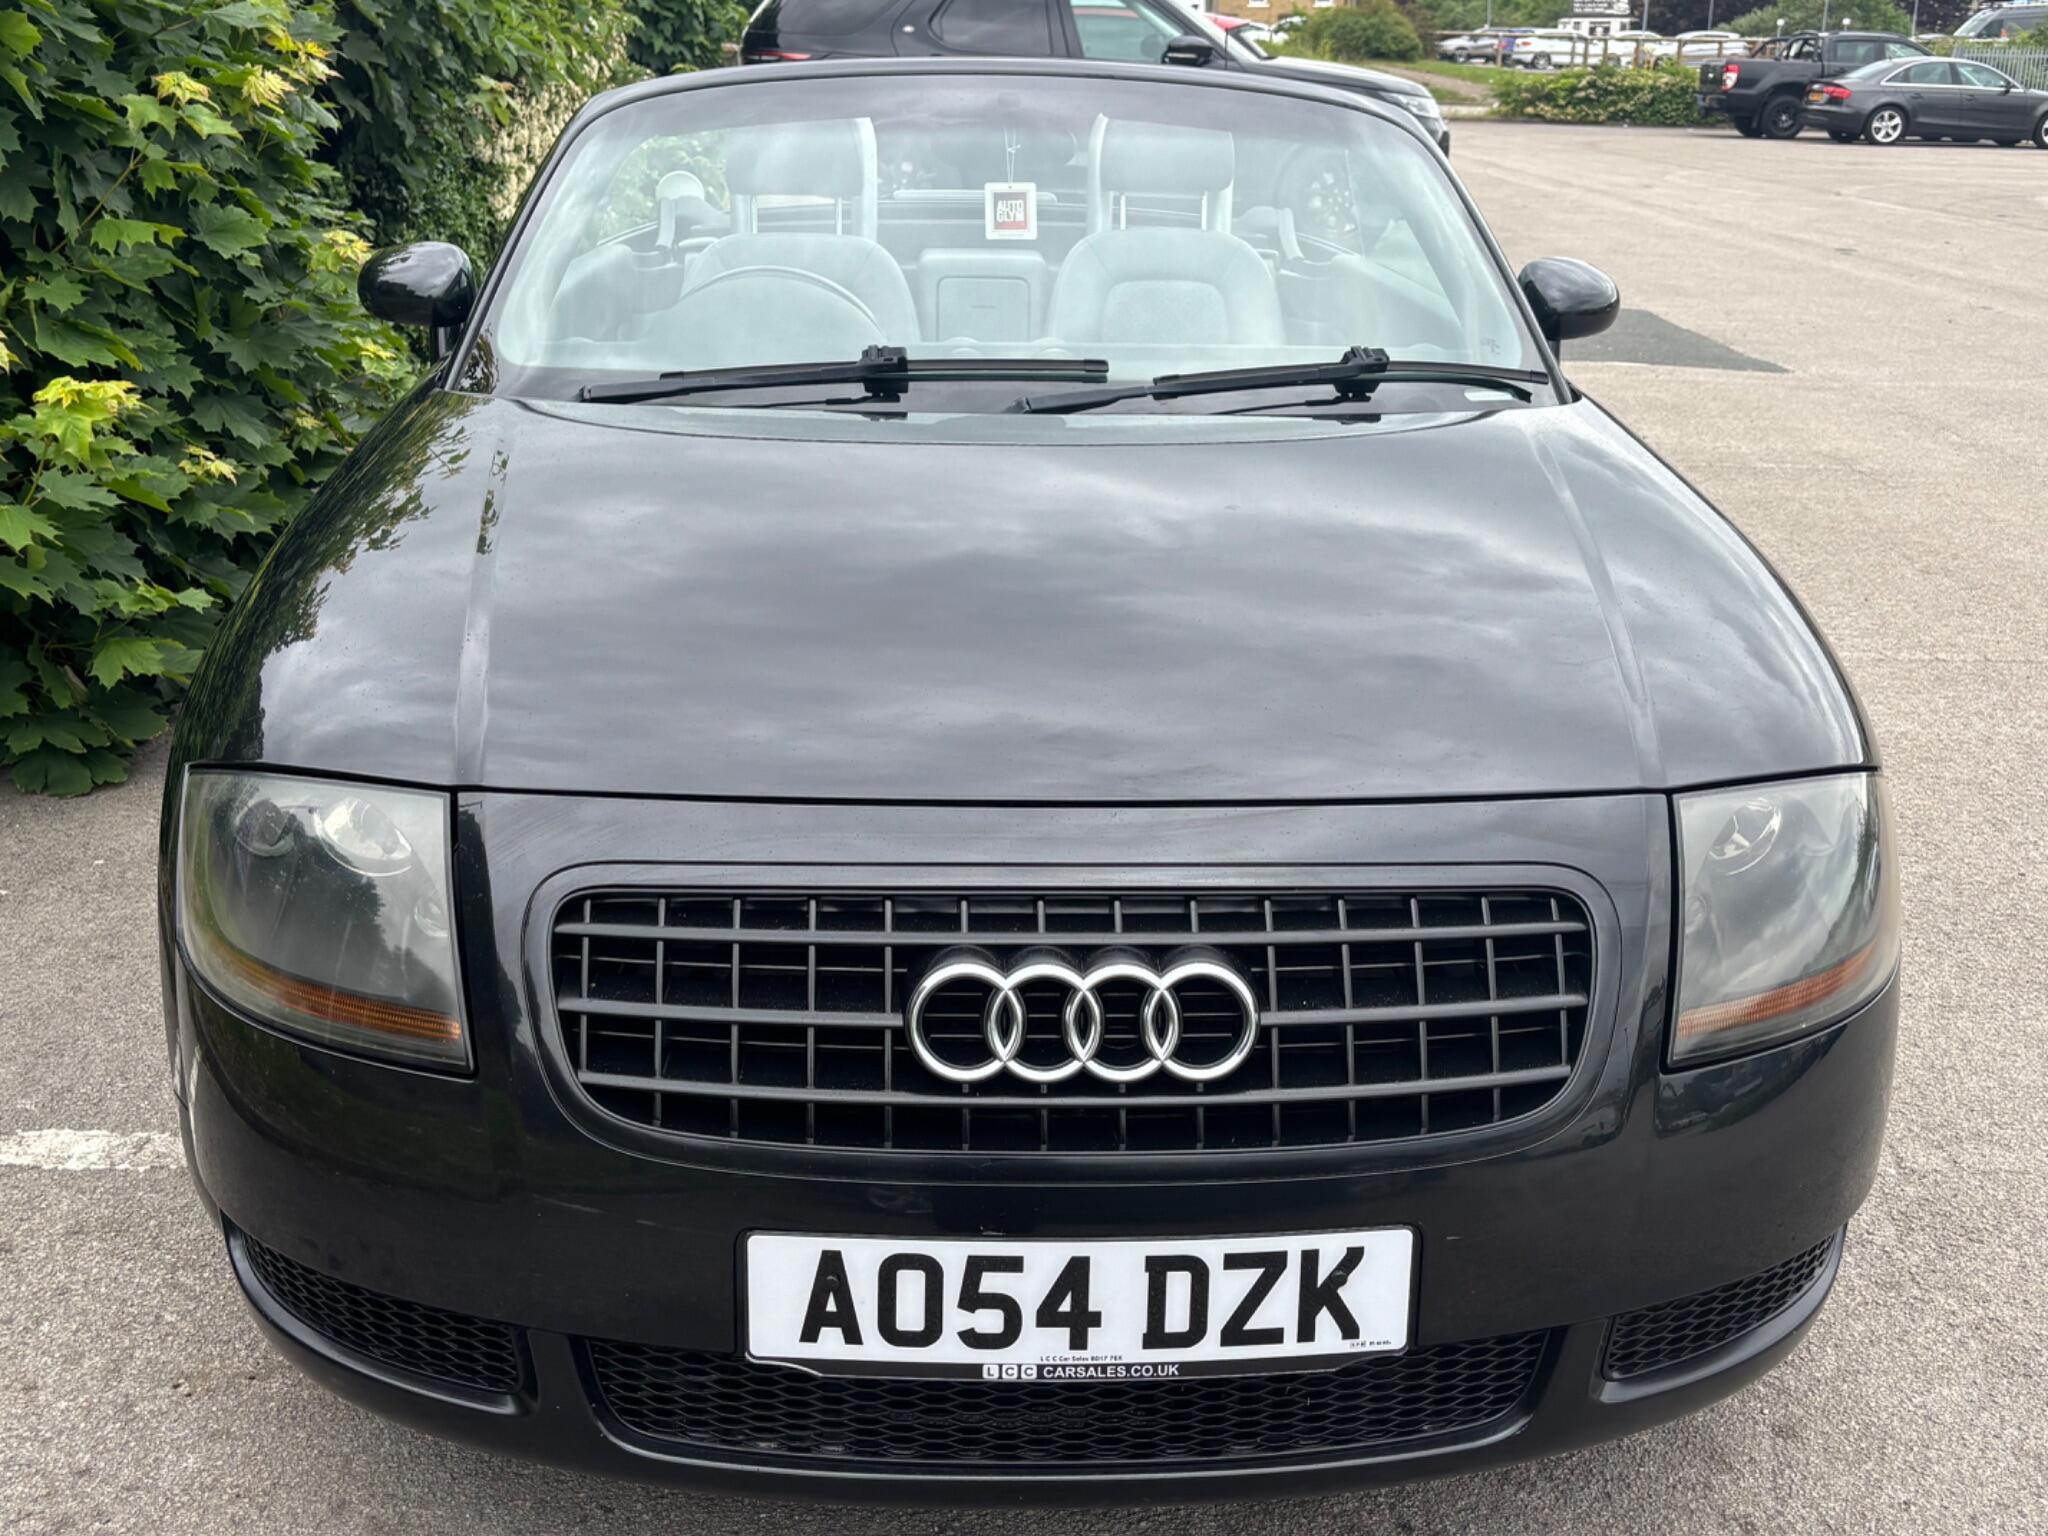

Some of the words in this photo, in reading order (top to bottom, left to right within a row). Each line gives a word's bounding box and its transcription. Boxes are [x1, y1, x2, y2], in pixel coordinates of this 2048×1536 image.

[997, 199, 1024, 210] AUTO
[799, 1250, 1102, 1351] AO54
[1142, 1246, 1365, 1350] DZK
[1043, 1364, 1180, 1378] CARSALES.CO.UK
